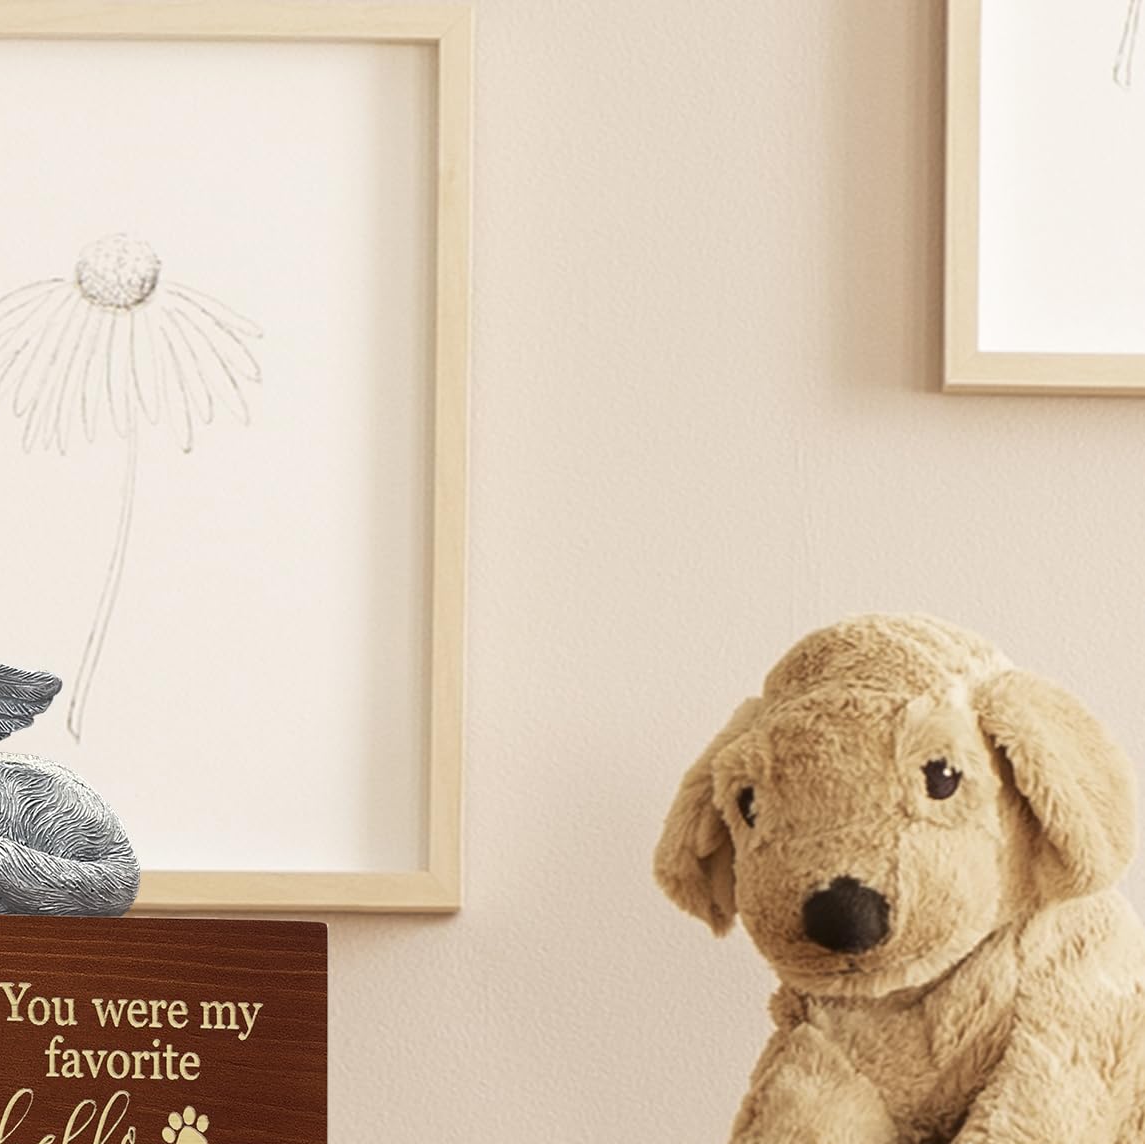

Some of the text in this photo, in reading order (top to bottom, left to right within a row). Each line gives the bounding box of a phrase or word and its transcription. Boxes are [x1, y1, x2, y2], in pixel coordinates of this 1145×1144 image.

[0, 982, 263, 1040] You were my
[45, 1035, 200, 1080] favorite
